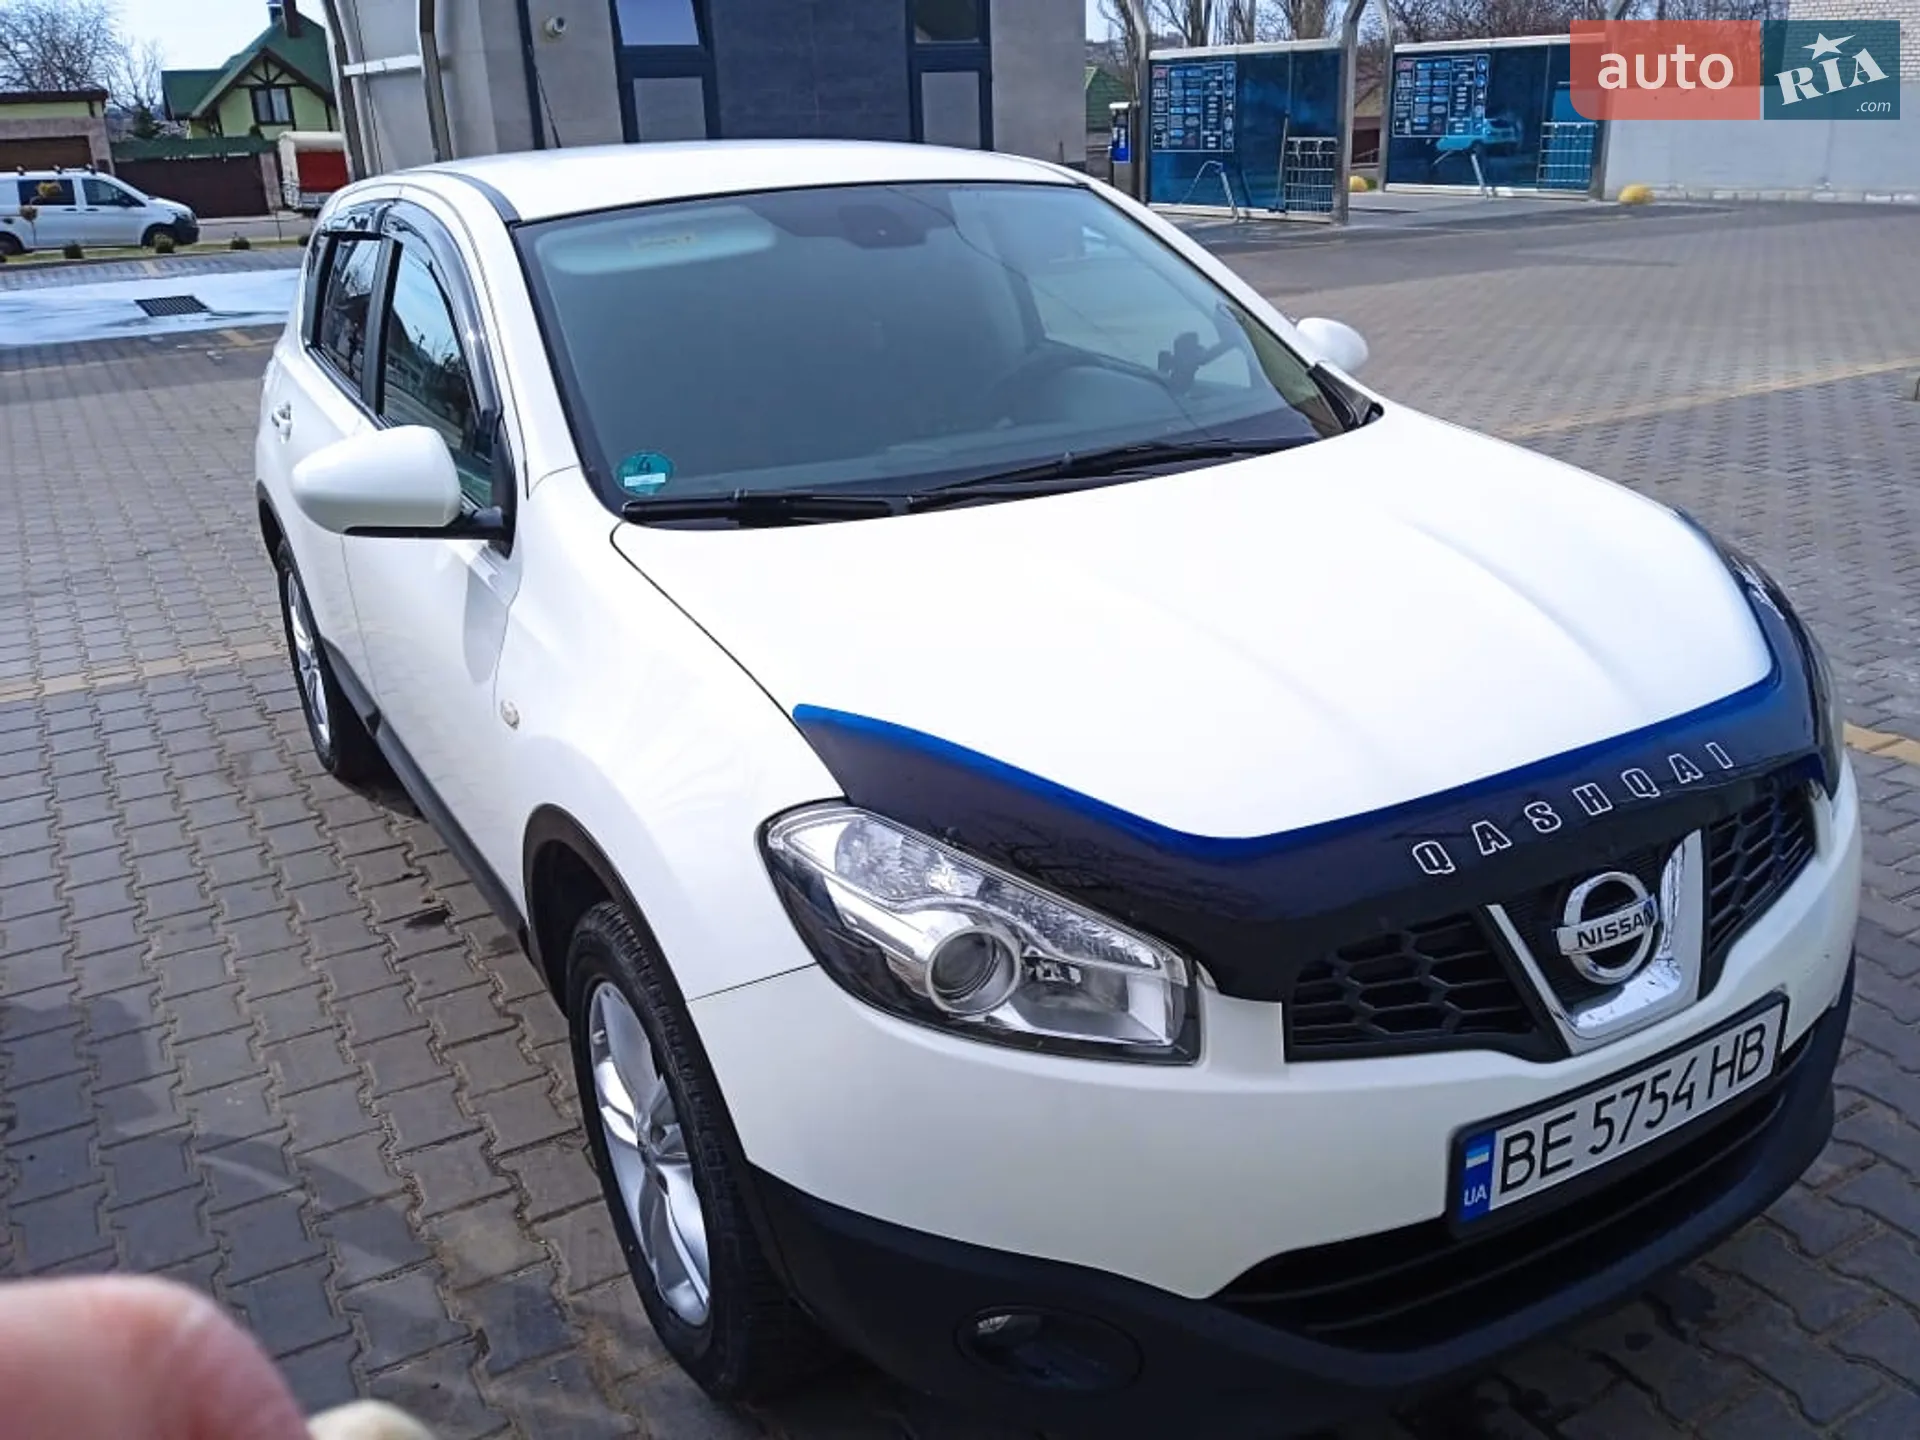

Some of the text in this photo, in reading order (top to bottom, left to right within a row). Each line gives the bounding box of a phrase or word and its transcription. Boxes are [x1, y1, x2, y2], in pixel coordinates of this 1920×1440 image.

[1412, 742, 1734, 874] QASHQAI
[1576, 902, 1655, 948] NISSAN
[1499, 1023, 1766, 1196] BE 5754 HB
[1463, 1184, 1487, 1207] UA
